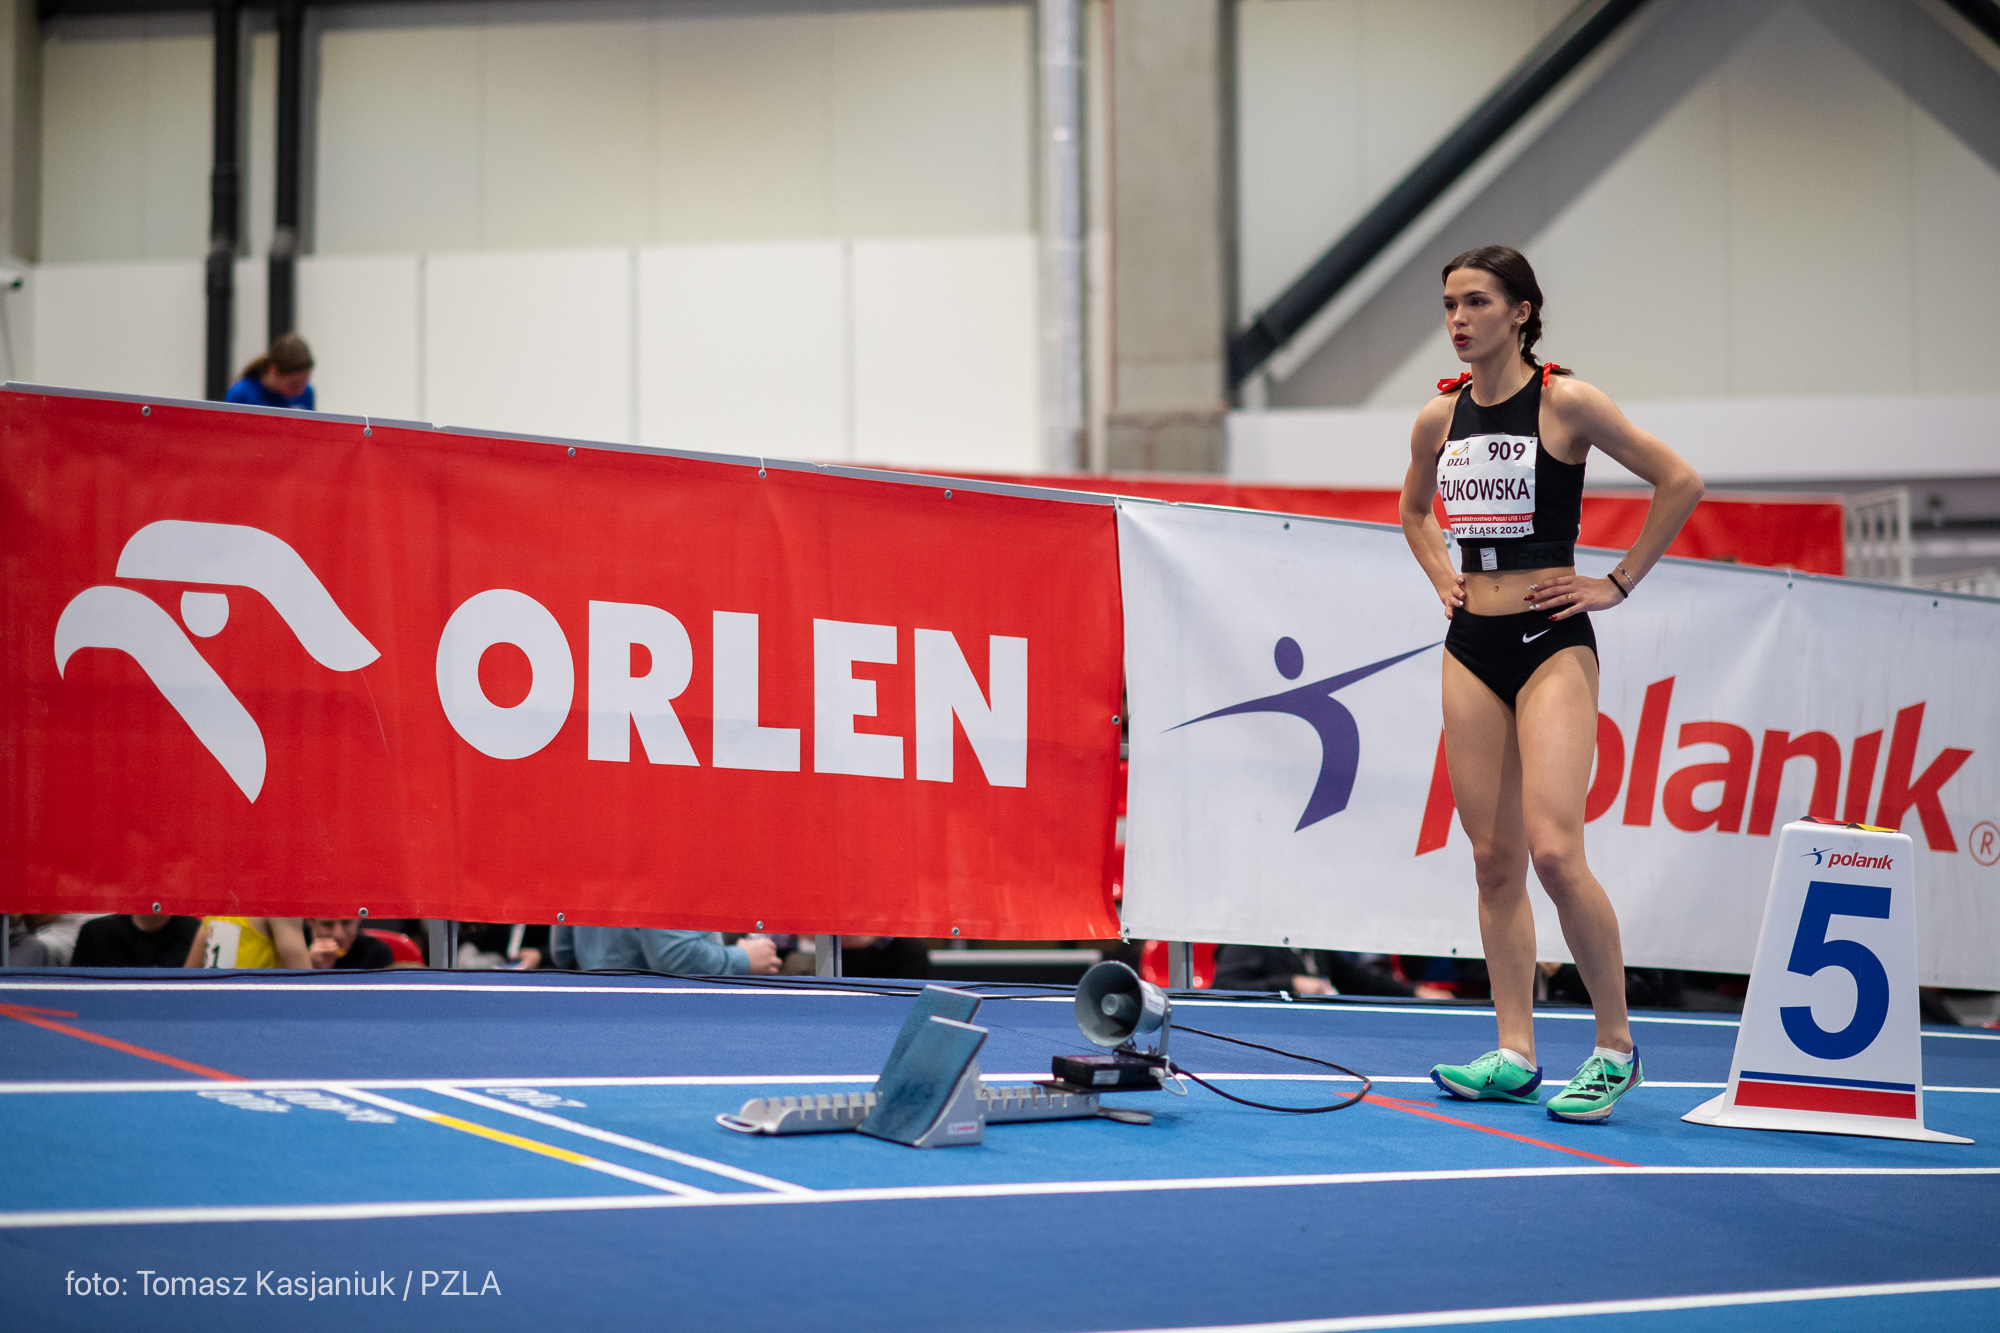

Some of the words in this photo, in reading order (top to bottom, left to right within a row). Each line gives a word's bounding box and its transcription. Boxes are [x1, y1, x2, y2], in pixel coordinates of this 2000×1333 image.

[1488, 441, 1526, 461] 909
[1447, 457, 1470, 467] DZLA
[1440, 475, 1531, 502] ŻUKOWSKA
[1469, 525, 1498, 536] ŚLĄSK
[1500, 526, 1525, 534] 2024
[436, 588, 1028, 788] ORLEN
[1827, 851, 1894, 870] polanik
[1779, 880, 1892, 1061] 5
